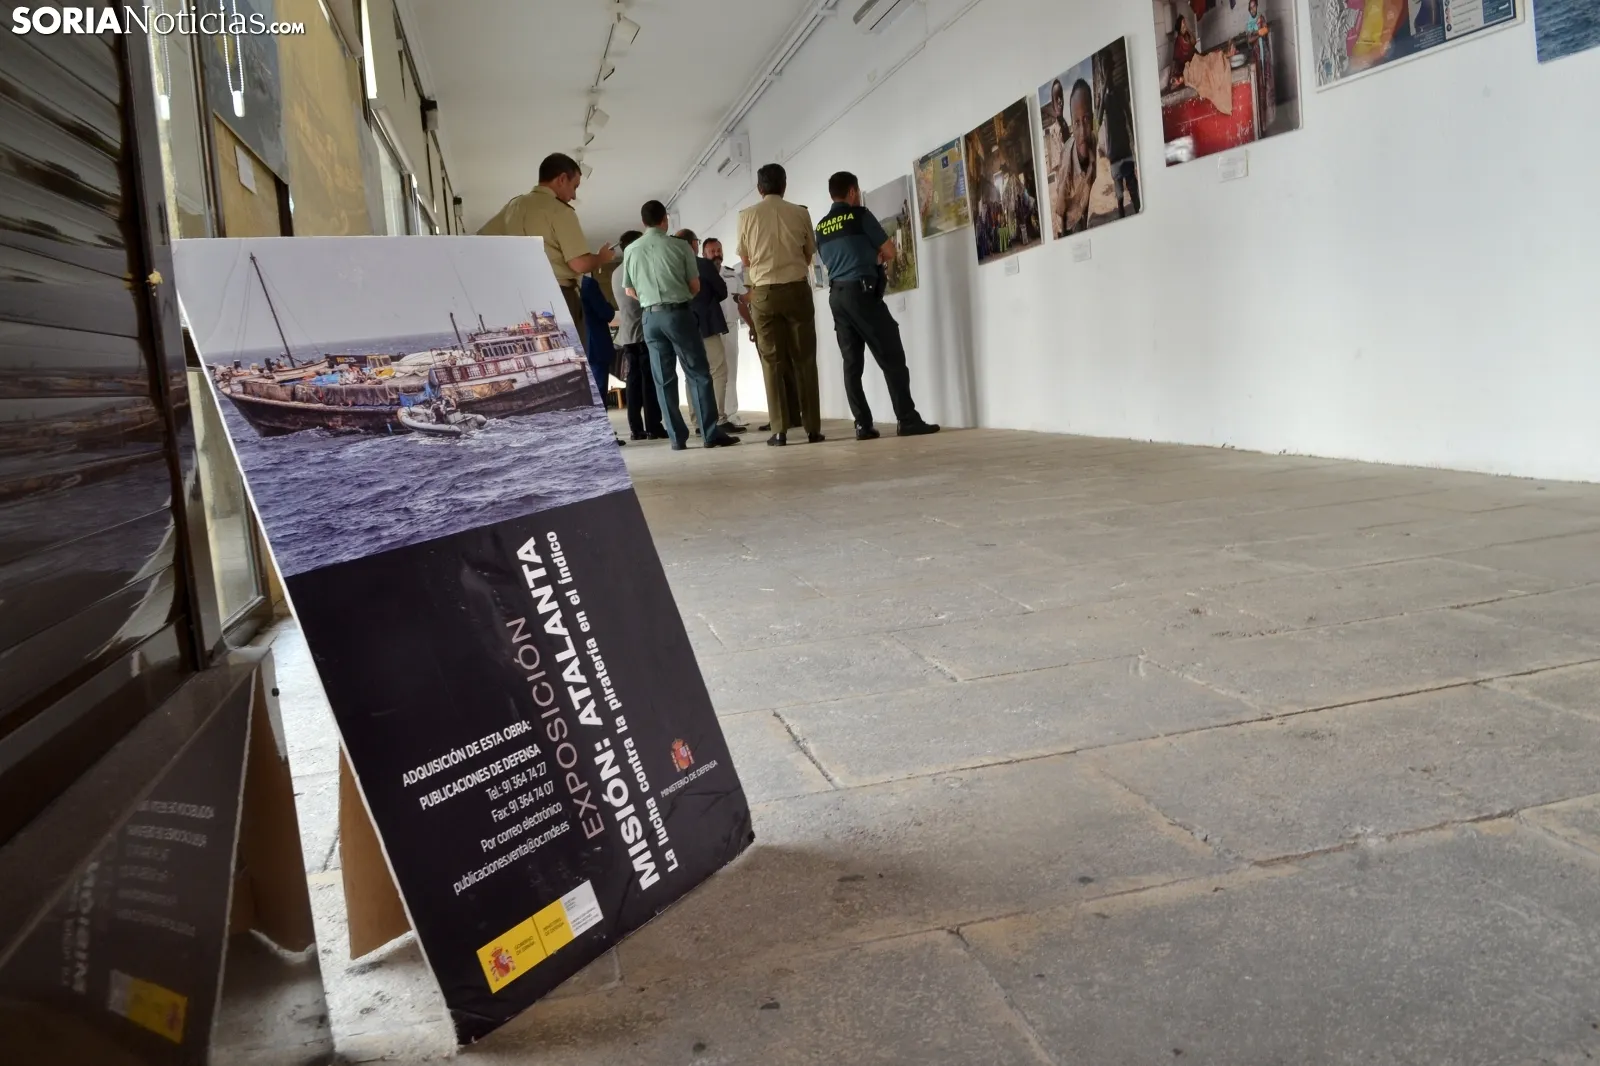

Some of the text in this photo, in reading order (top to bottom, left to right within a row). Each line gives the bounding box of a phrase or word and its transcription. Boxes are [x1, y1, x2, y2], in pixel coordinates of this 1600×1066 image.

[816, 213, 854, 232] GUARDIA
[822, 222, 843, 235] CIVIL
[516, 536, 660, 891] MISIÓN: ATALANTA
[546, 531, 679, 872] La lucha contra la piratería en el Índico
[506, 617, 605, 839] EXPOSICIÓN
[402, 720, 532, 787] ADQUISICIÓN DE ESTA OBRA:
[419, 743, 542, 811] PUBLICACIONES DE DEFENSA
[502, 780, 513, 794] 91
[511, 772, 527, 788] 364
[526, 766, 538, 780] 74
[536, 761, 547, 776] 27
[660, 759, 718, 798] MINISTERIO DE DEFENSA
[508, 799, 519, 813] 91
[517, 792, 534, 808] 364
[533, 786, 545, 800] 74
[543, 780, 554, 795] 07
[480, 802, 563, 852] Por correo electrónico
